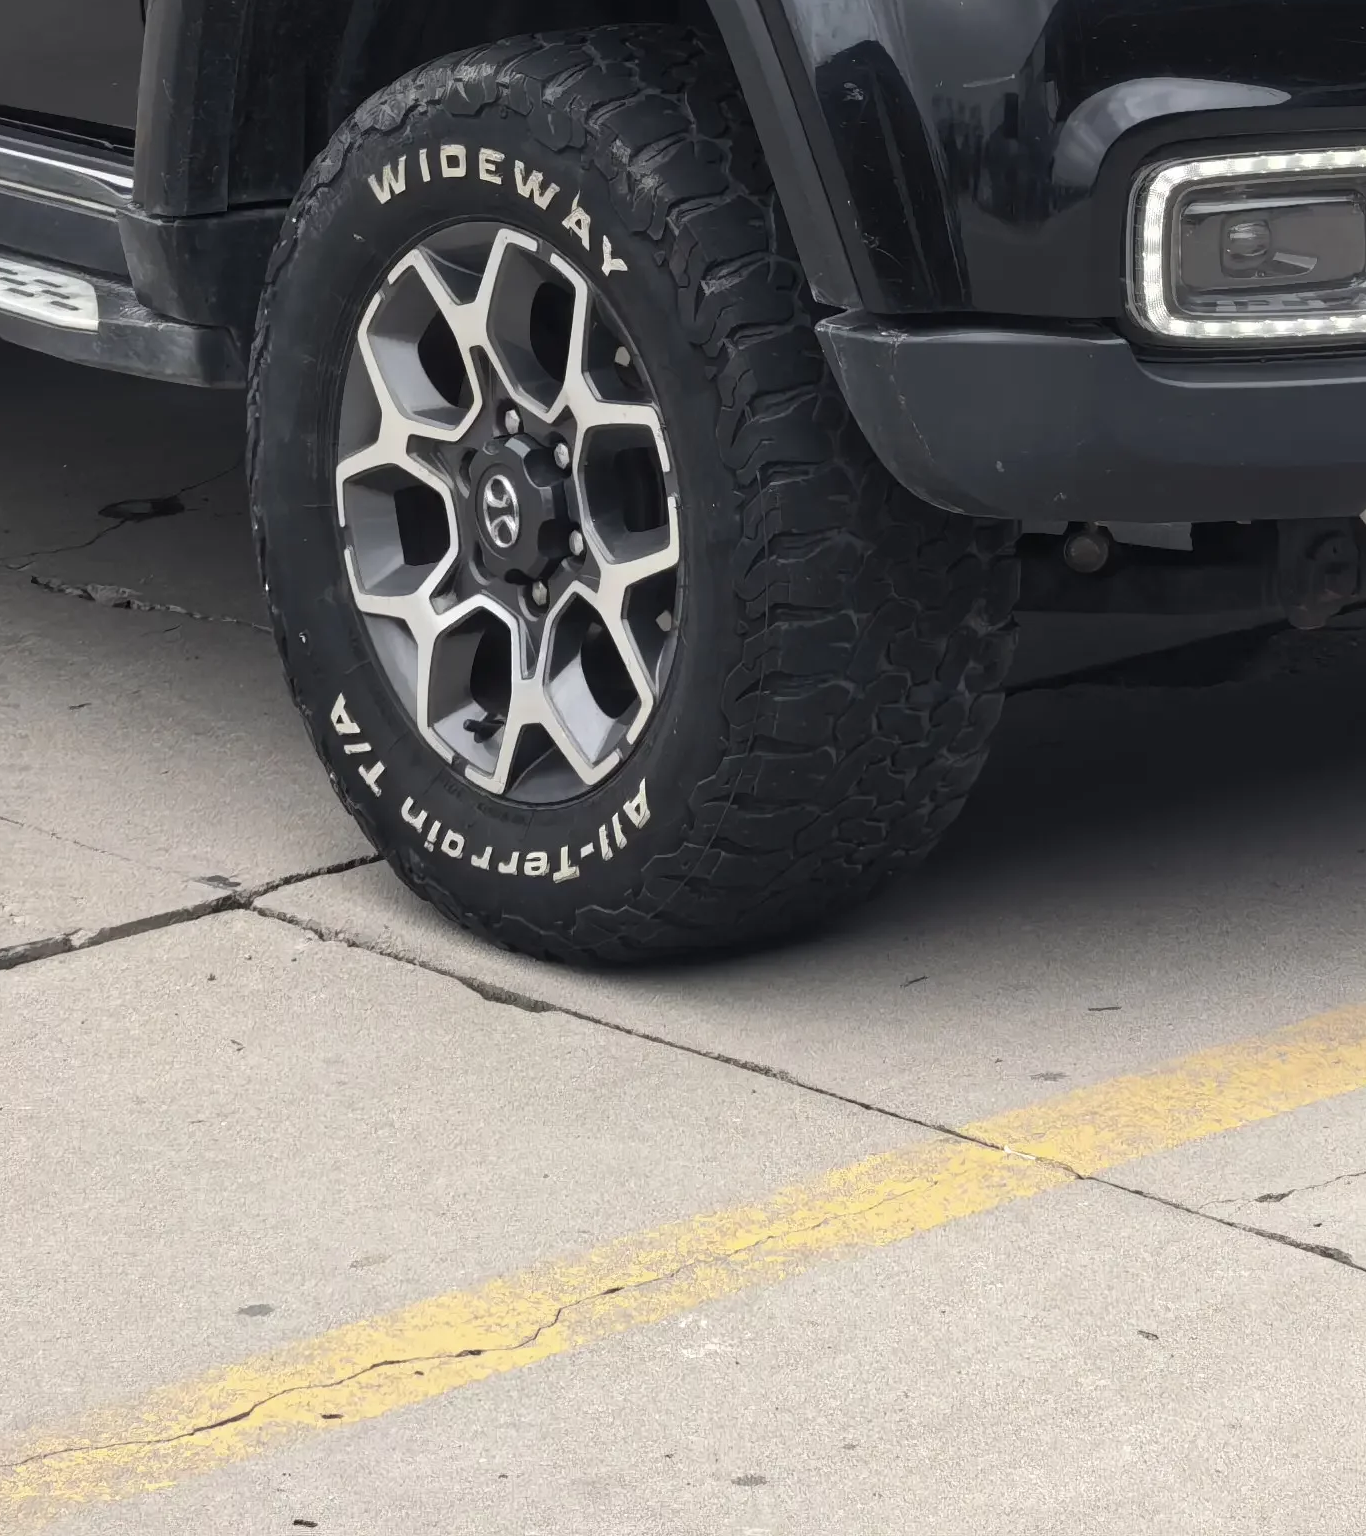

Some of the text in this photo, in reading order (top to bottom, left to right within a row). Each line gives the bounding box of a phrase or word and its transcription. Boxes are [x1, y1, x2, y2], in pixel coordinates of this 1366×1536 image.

[367, 144, 628, 277] WIDEWAY
[330, 692, 386, 797] T/A
[401, 777, 651, 884] All-Terrain
